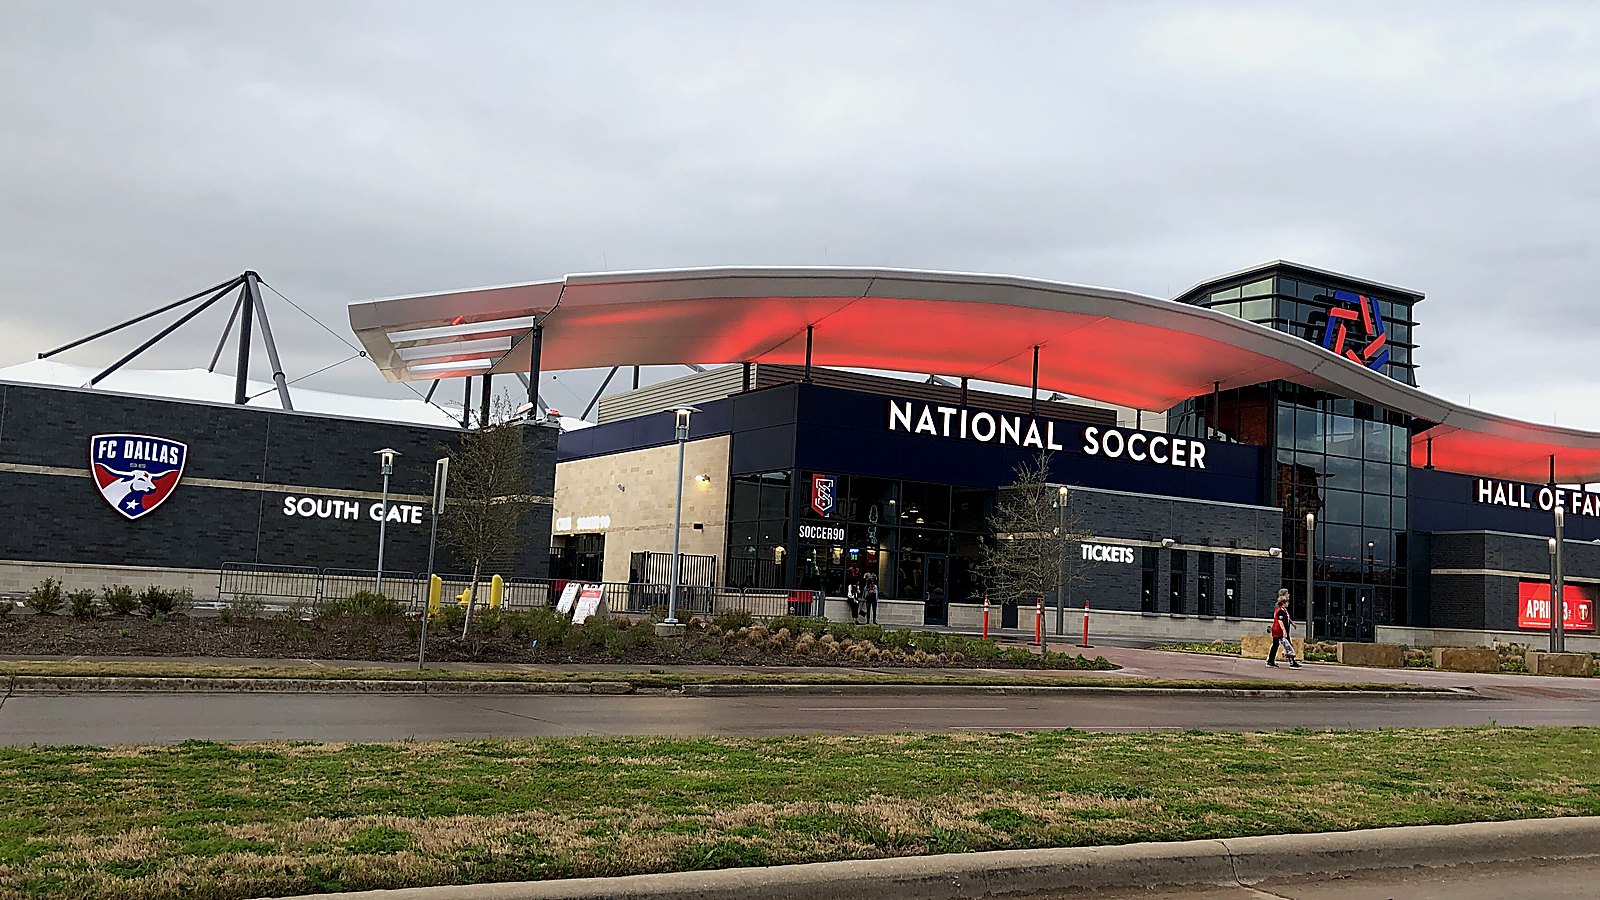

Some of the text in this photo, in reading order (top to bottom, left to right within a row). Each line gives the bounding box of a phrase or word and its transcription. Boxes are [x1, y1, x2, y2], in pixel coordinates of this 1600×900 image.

[888, 399, 1206, 469] NATIONAL SOCCER
[99, 440, 179, 465] FC DALLAS
[1478, 478, 1531, 509] HALL
[1538, 487, 1565, 511] OF
[283, 496, 423, 524] SOUTH GATE
[799, 525, 845, 541] SOCCER90
[1080, 544, 1135, 564] TICKETS
